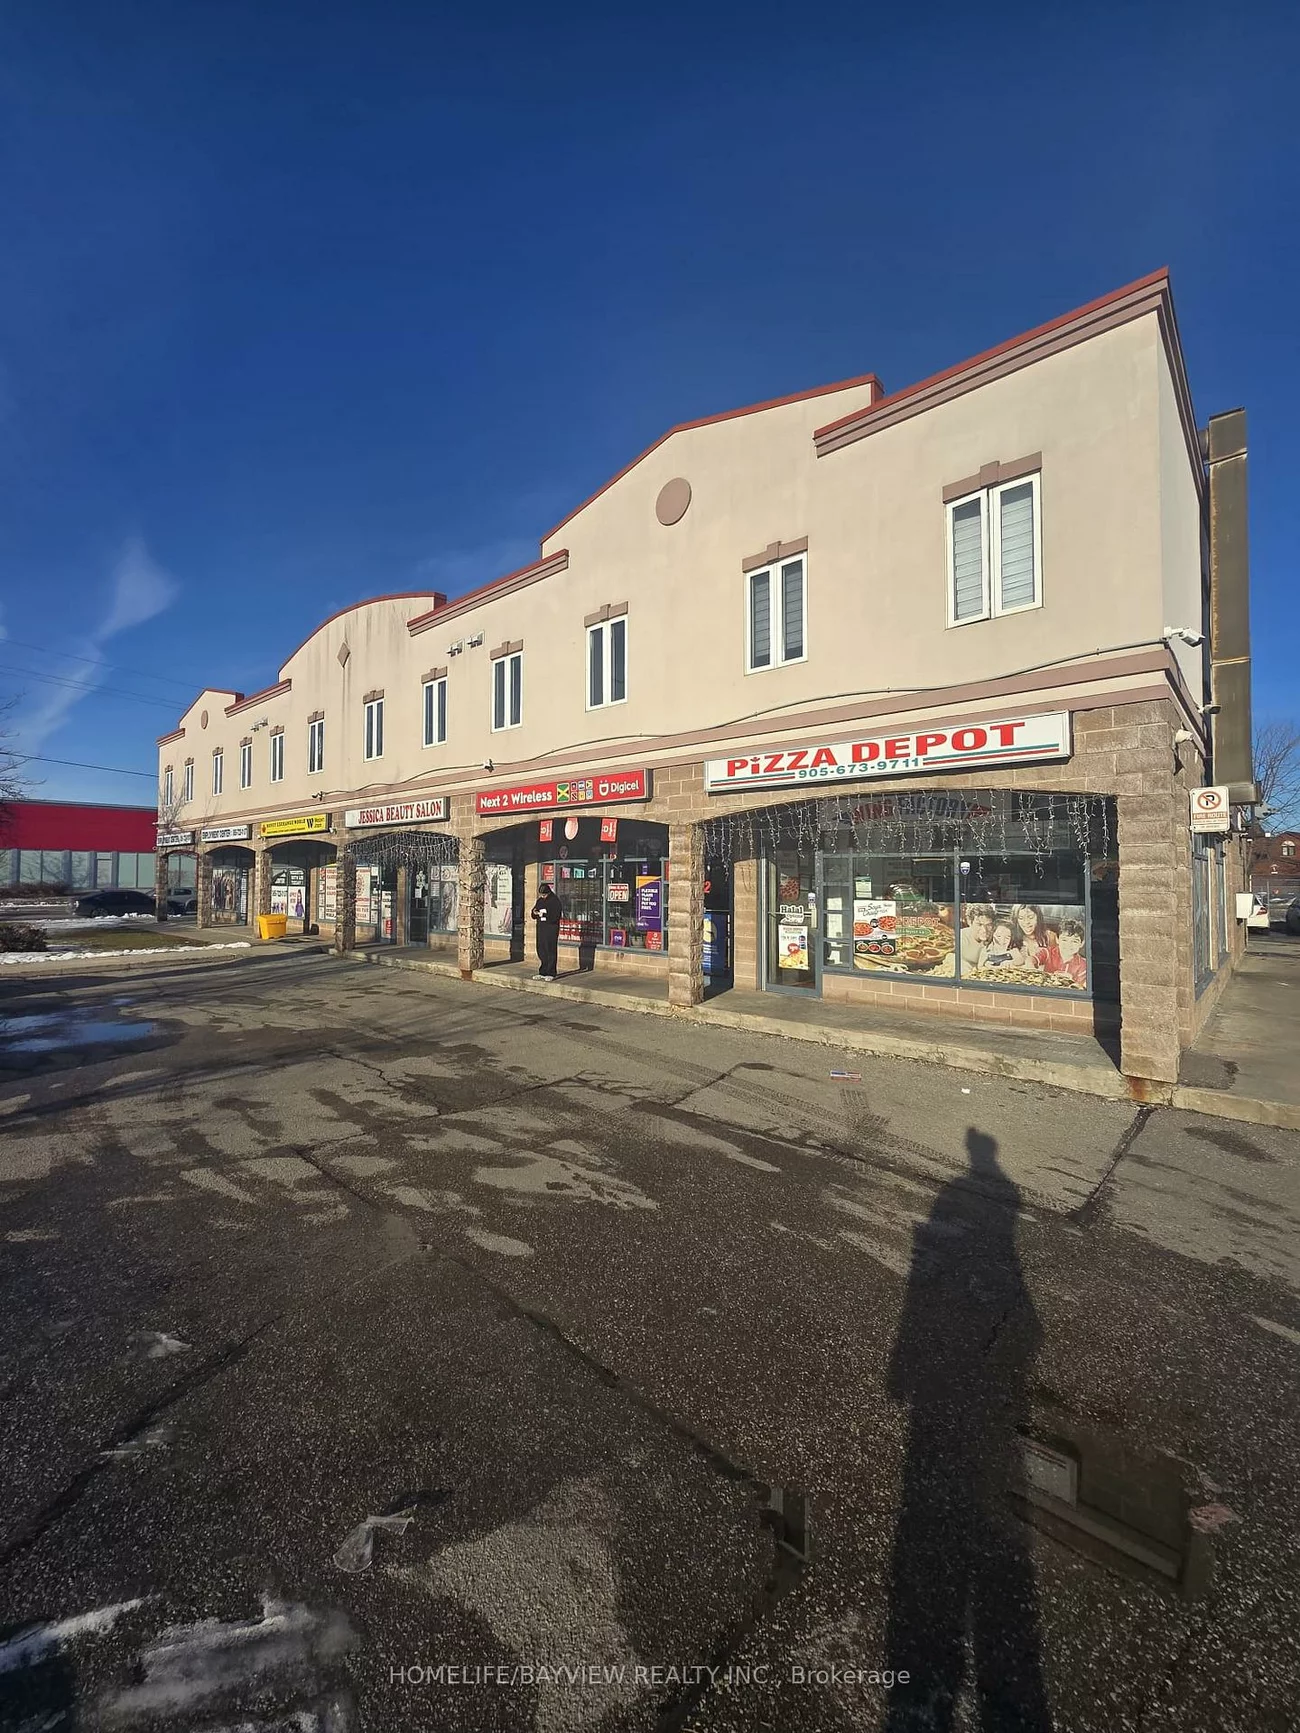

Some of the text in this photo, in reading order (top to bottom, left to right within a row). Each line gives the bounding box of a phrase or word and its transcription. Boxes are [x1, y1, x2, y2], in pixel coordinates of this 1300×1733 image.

[851, 722, 1026, 764] DEPOT
[798, 757, 920, 780] 905-673-9711
[610, 779, 640, 794] Digicel
[480, 790, 553, 809] Next 2 Wireless
[358, 800, 442, 824] JESSICA BEAUTY SALON
[609, 890, 628, 901] OPEN
[780, 905, 803, 914] Halal
